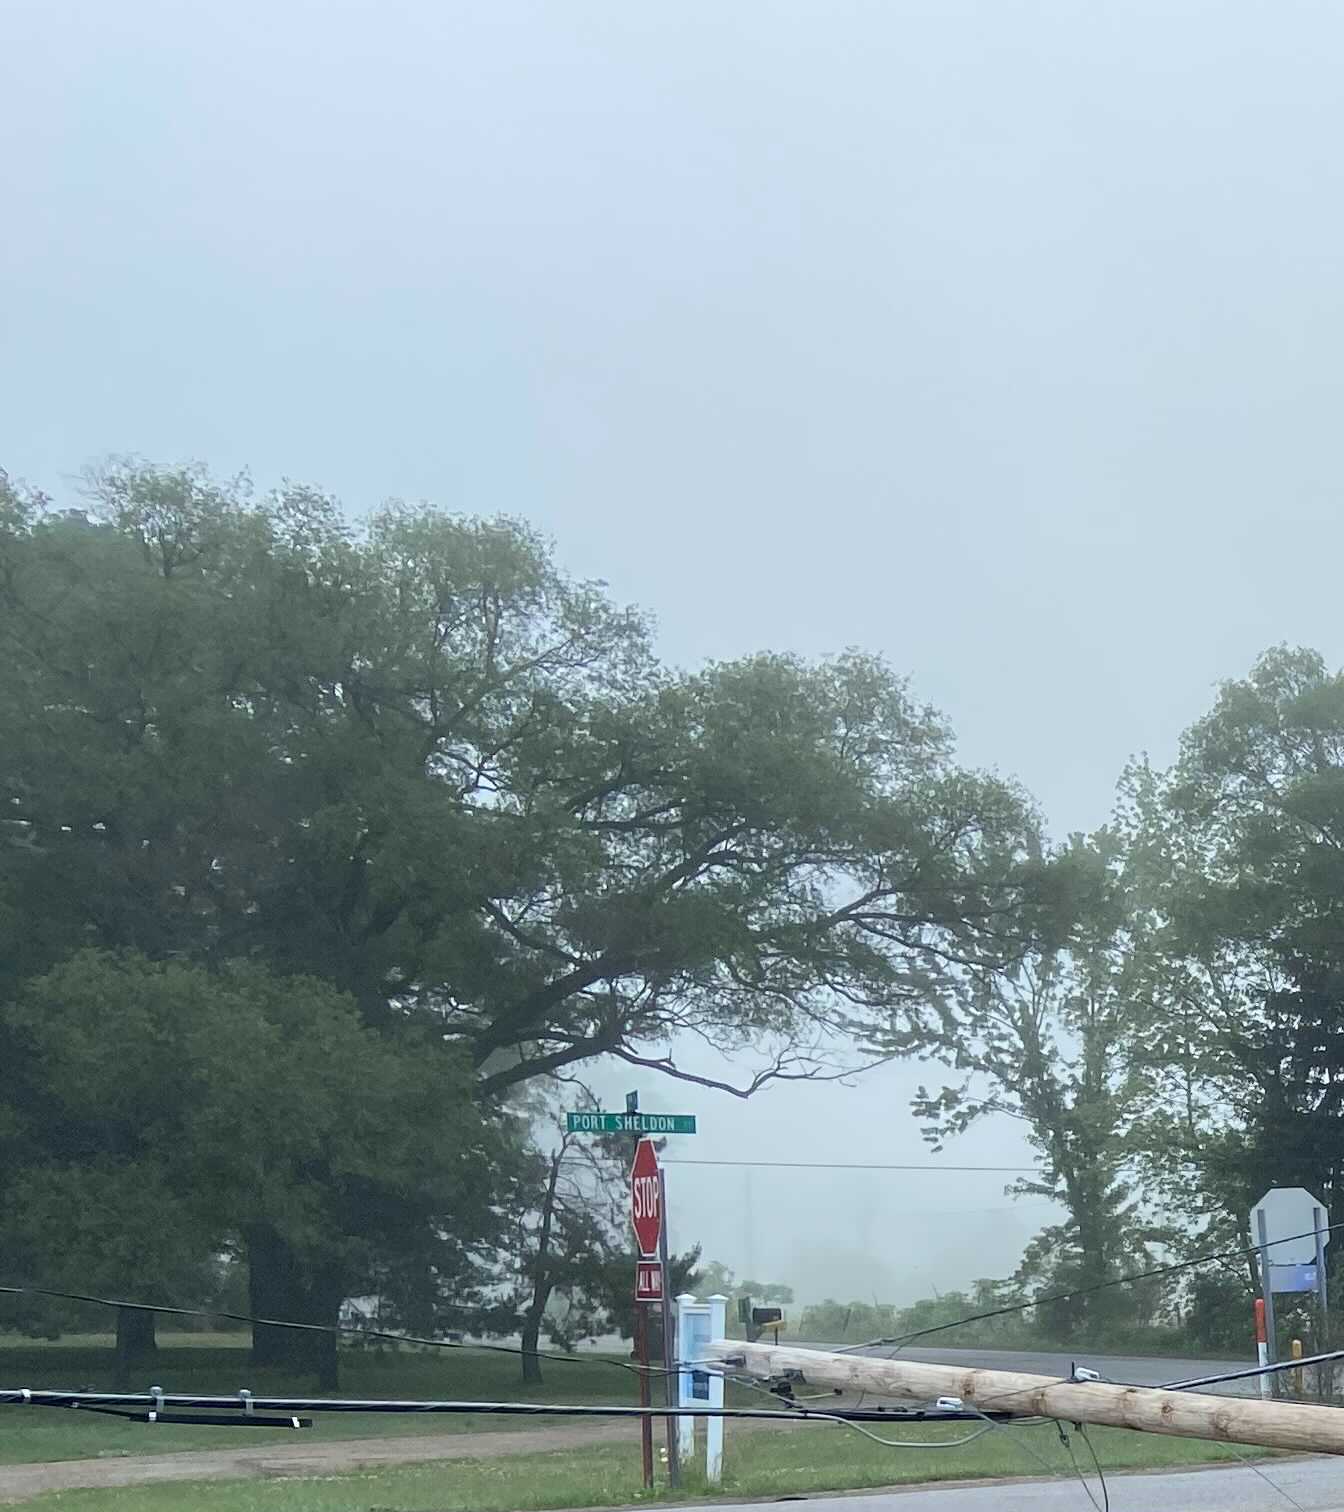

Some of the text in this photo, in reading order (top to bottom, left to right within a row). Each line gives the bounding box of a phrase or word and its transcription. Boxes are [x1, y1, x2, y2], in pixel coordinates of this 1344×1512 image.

[573, 1115, 606, 1129] PORT
[615, 1115, 675, 1130] SHELDON
[634, 1176, 660, 1218] STOP
